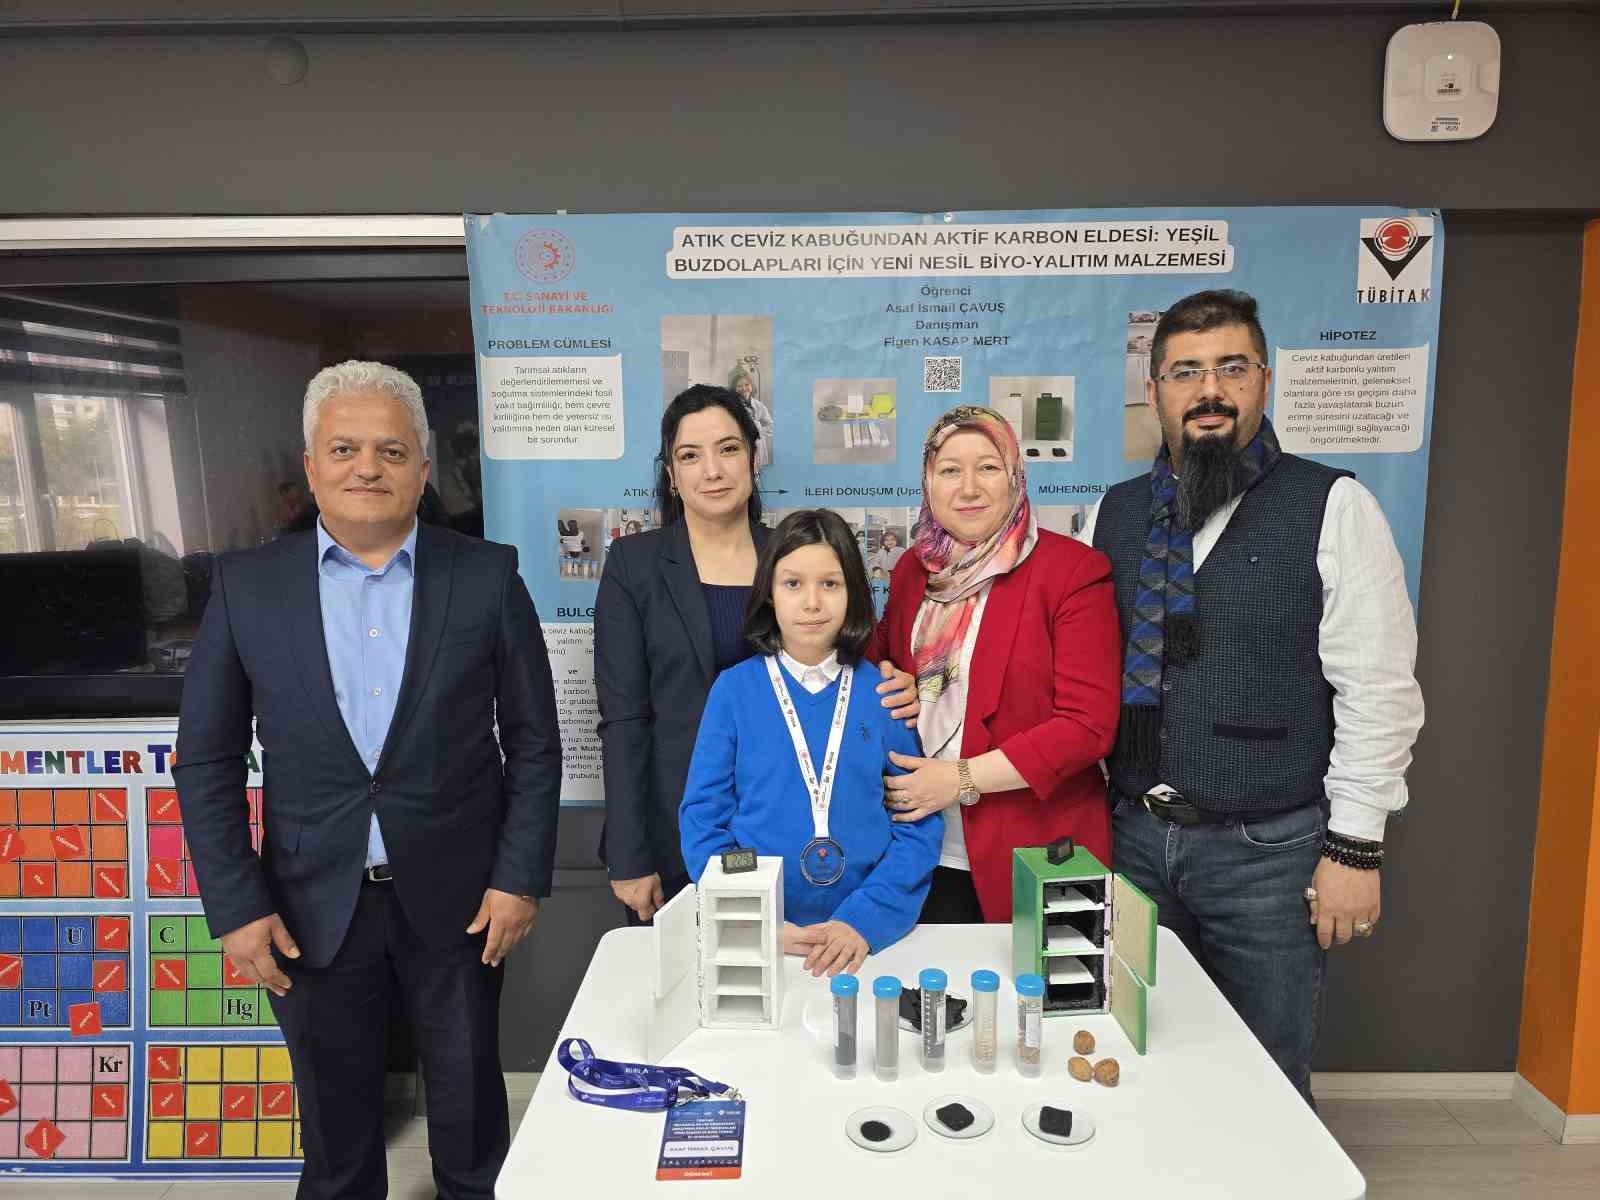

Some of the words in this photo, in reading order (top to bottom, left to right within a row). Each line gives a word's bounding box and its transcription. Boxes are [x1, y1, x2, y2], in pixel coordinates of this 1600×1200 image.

[682, 233, 725, 248] ATIK
[731, 230, 786, 248] CEVİZ
[791, 230, 927, 248] KABUĞUNDAN
[934, 229, 989, 245] AKTİF
[995, 230, 1078, 245] KARBON
[1084, 226, 1159, 243] ELDESİ:
[1166, 225, 1220, 245] YEŞİL
[675, 257, 821, 272] BUZDOLAPLARI
[827, 254, 864, 274] İÇİN
[871, 253, 913, 270] YENİ
[919, 253, 974, 270] NESİL
[980, 252, 1108, 269] BİYO-YALITIM
[1114, 250, 1226, 267] MALZEMESİ
[1356, 286, 1432, 303] TÜBİTAK
[886, 303, 914, 313] Asaf
[959, 302, 1006, 315] ÇAVUŞ
[915, 320, 979, 331] Danışman
[488, 339, 550, 349] PROBLEM
[553, 337, 612, 349] CÜMLESİ
[973, 336, 1009, 346] MERT
[1320, 329, 1377, 341] HİPOTEZ
[1291, 353, 1318, 361] Ceviz
[623, 488, 649, 497] ATIK
[66, 927, 85, 945] U
[159, 926, 176, 944] C
[28, 999, 52, 1017] Pt
[226, 998, 253, 1020] Hg
[98, 1056, 123, 1073] Kr
